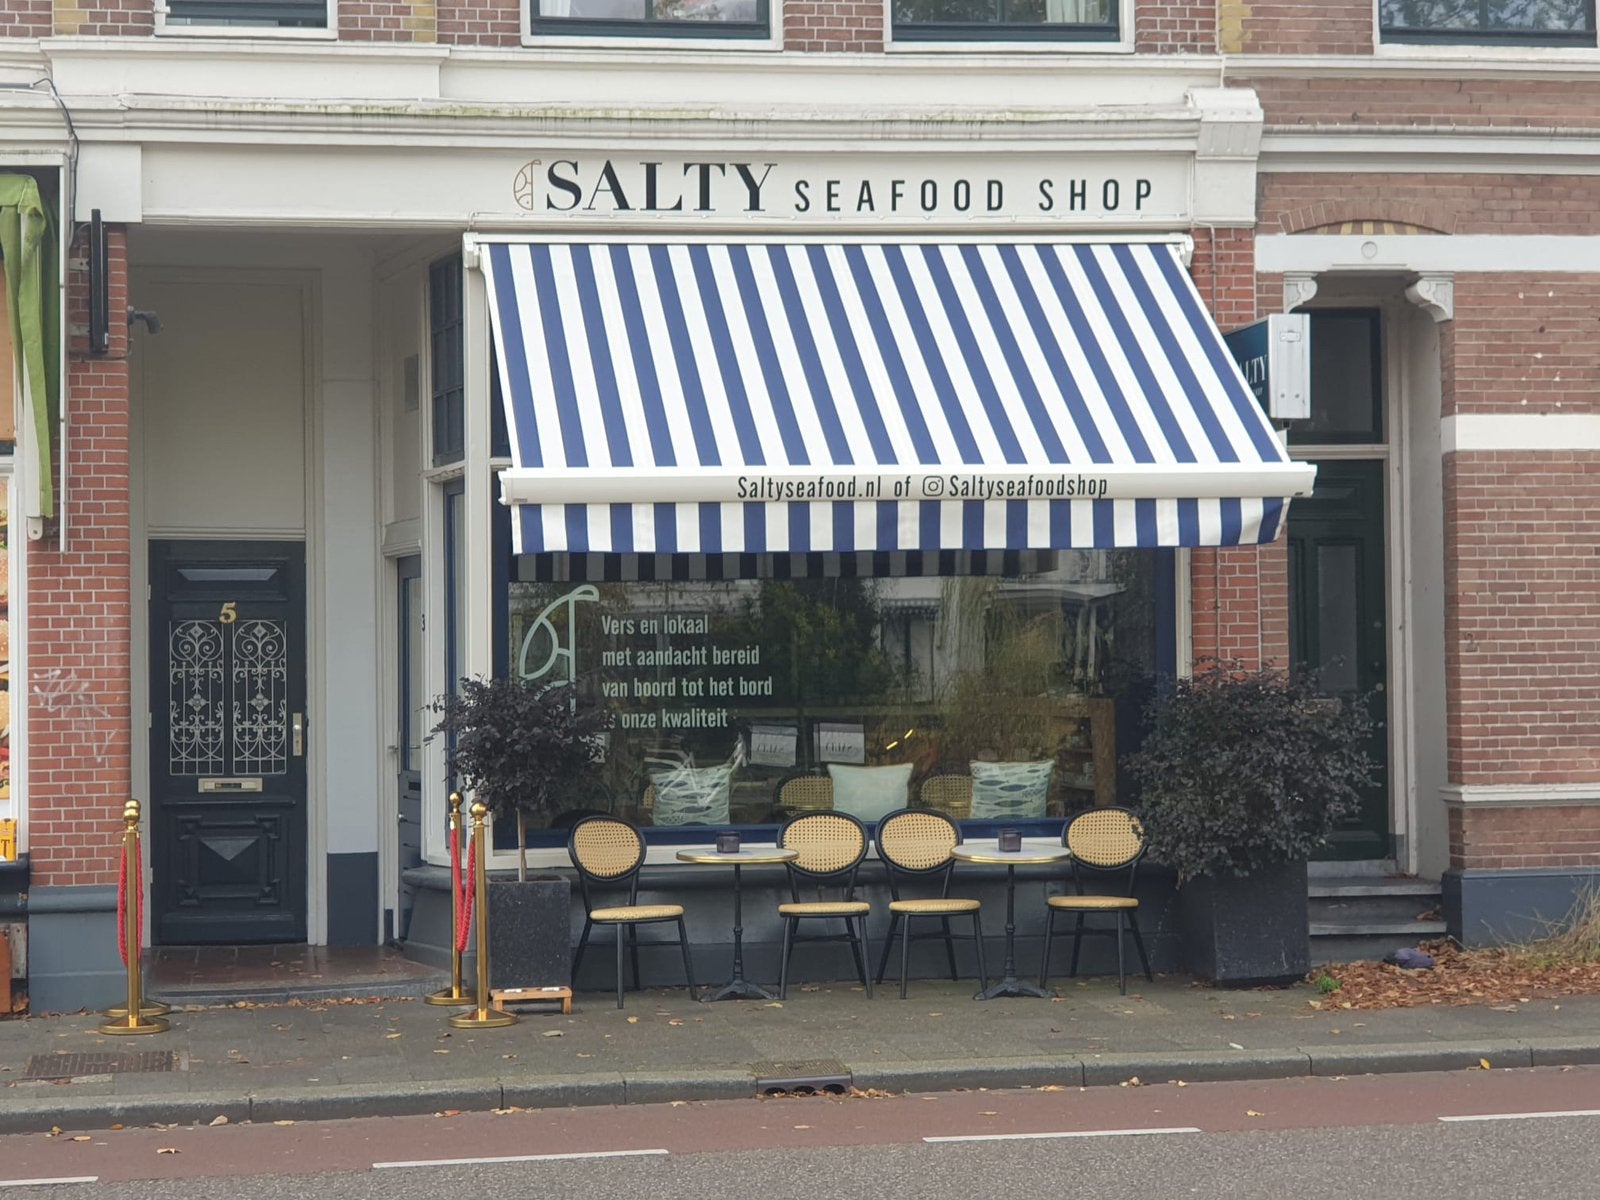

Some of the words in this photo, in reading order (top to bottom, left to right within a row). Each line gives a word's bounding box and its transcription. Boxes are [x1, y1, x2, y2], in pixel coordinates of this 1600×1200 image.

[546, 159, 778, 212] SALTY
[794, 179, 1004, 212] SEAFOOD
[1038, 178, 1151, 211] SHOP
[737, 476, 881, 501] Saltyseafood.nl
[894, 475, 911, 497] of
[949, 474, 1107, 500] Saltyseafoodshop
[219, 602, 237, 624] 5
[601, 615, 635, 635] Vers
[640, 620, 658, 635] en
[663, 614, 708, 634] lokaal
[602, 647, 632, 667] met
[636, 646, 707, 666] aandacht
[712, 645, 760, 665] bereid
[602, 681, 628, 698] van
[633, 677, 676, 697] boord
[681, 677, 704, 697] tot
[709, 676, 734, 696] het
[739, 676, 773, 696] bord
[621, 712, 657, 729] onze
[661, 707, 728, 728] kwaliteit
